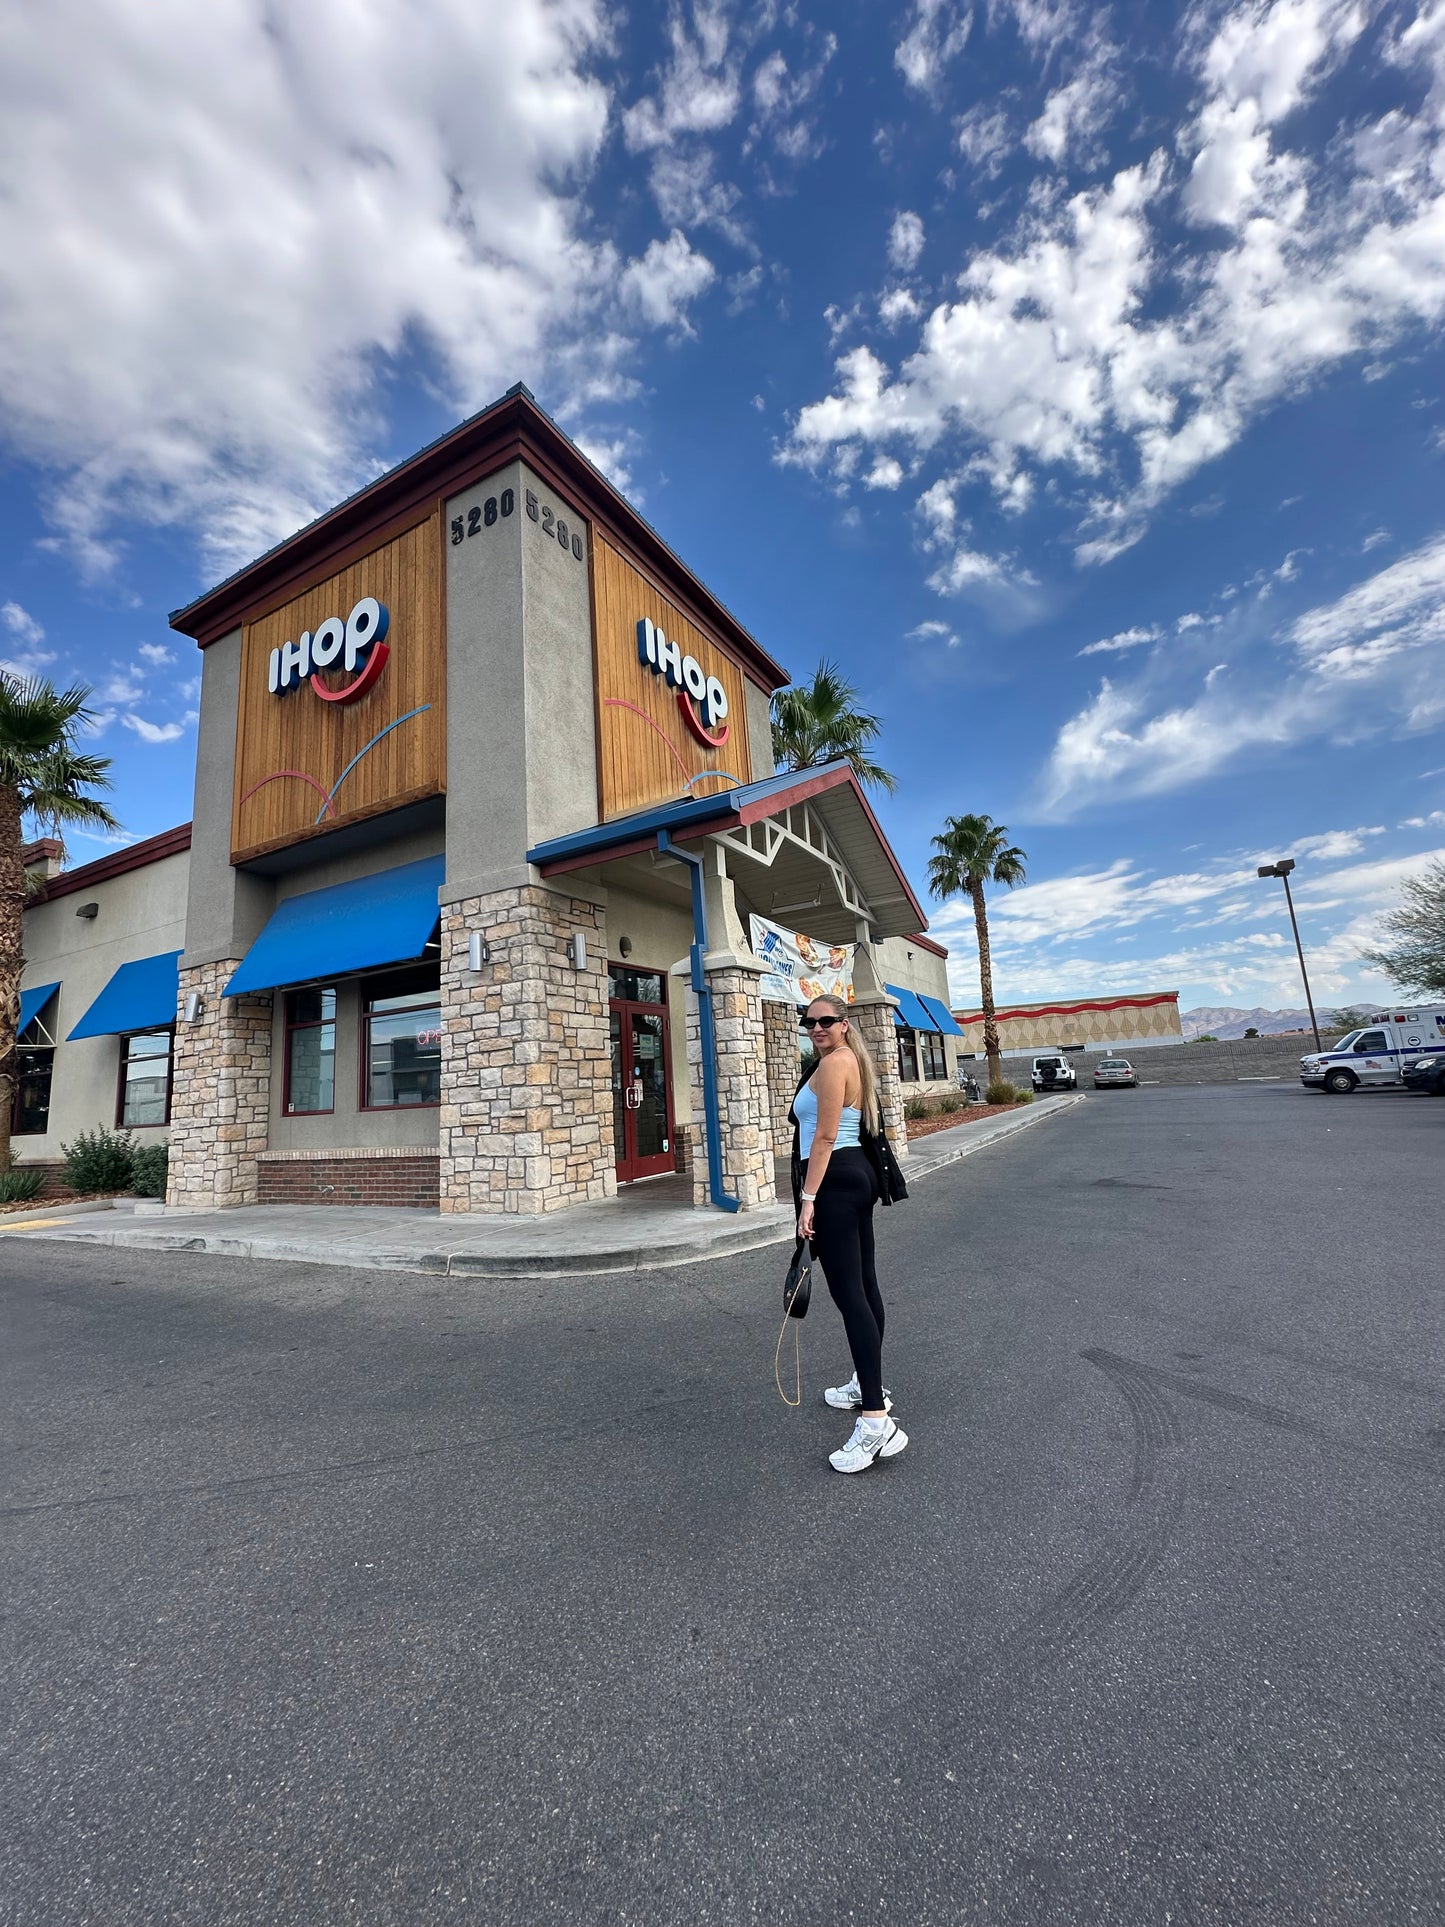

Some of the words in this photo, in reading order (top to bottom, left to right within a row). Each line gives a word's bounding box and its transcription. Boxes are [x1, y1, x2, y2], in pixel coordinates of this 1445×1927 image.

[451, 488, 515, 546] 5280
[525, 488, 584, 562] 5280
[268, 596, 389, 698] IHOP
[637, 617, 729, 729] IHOP
